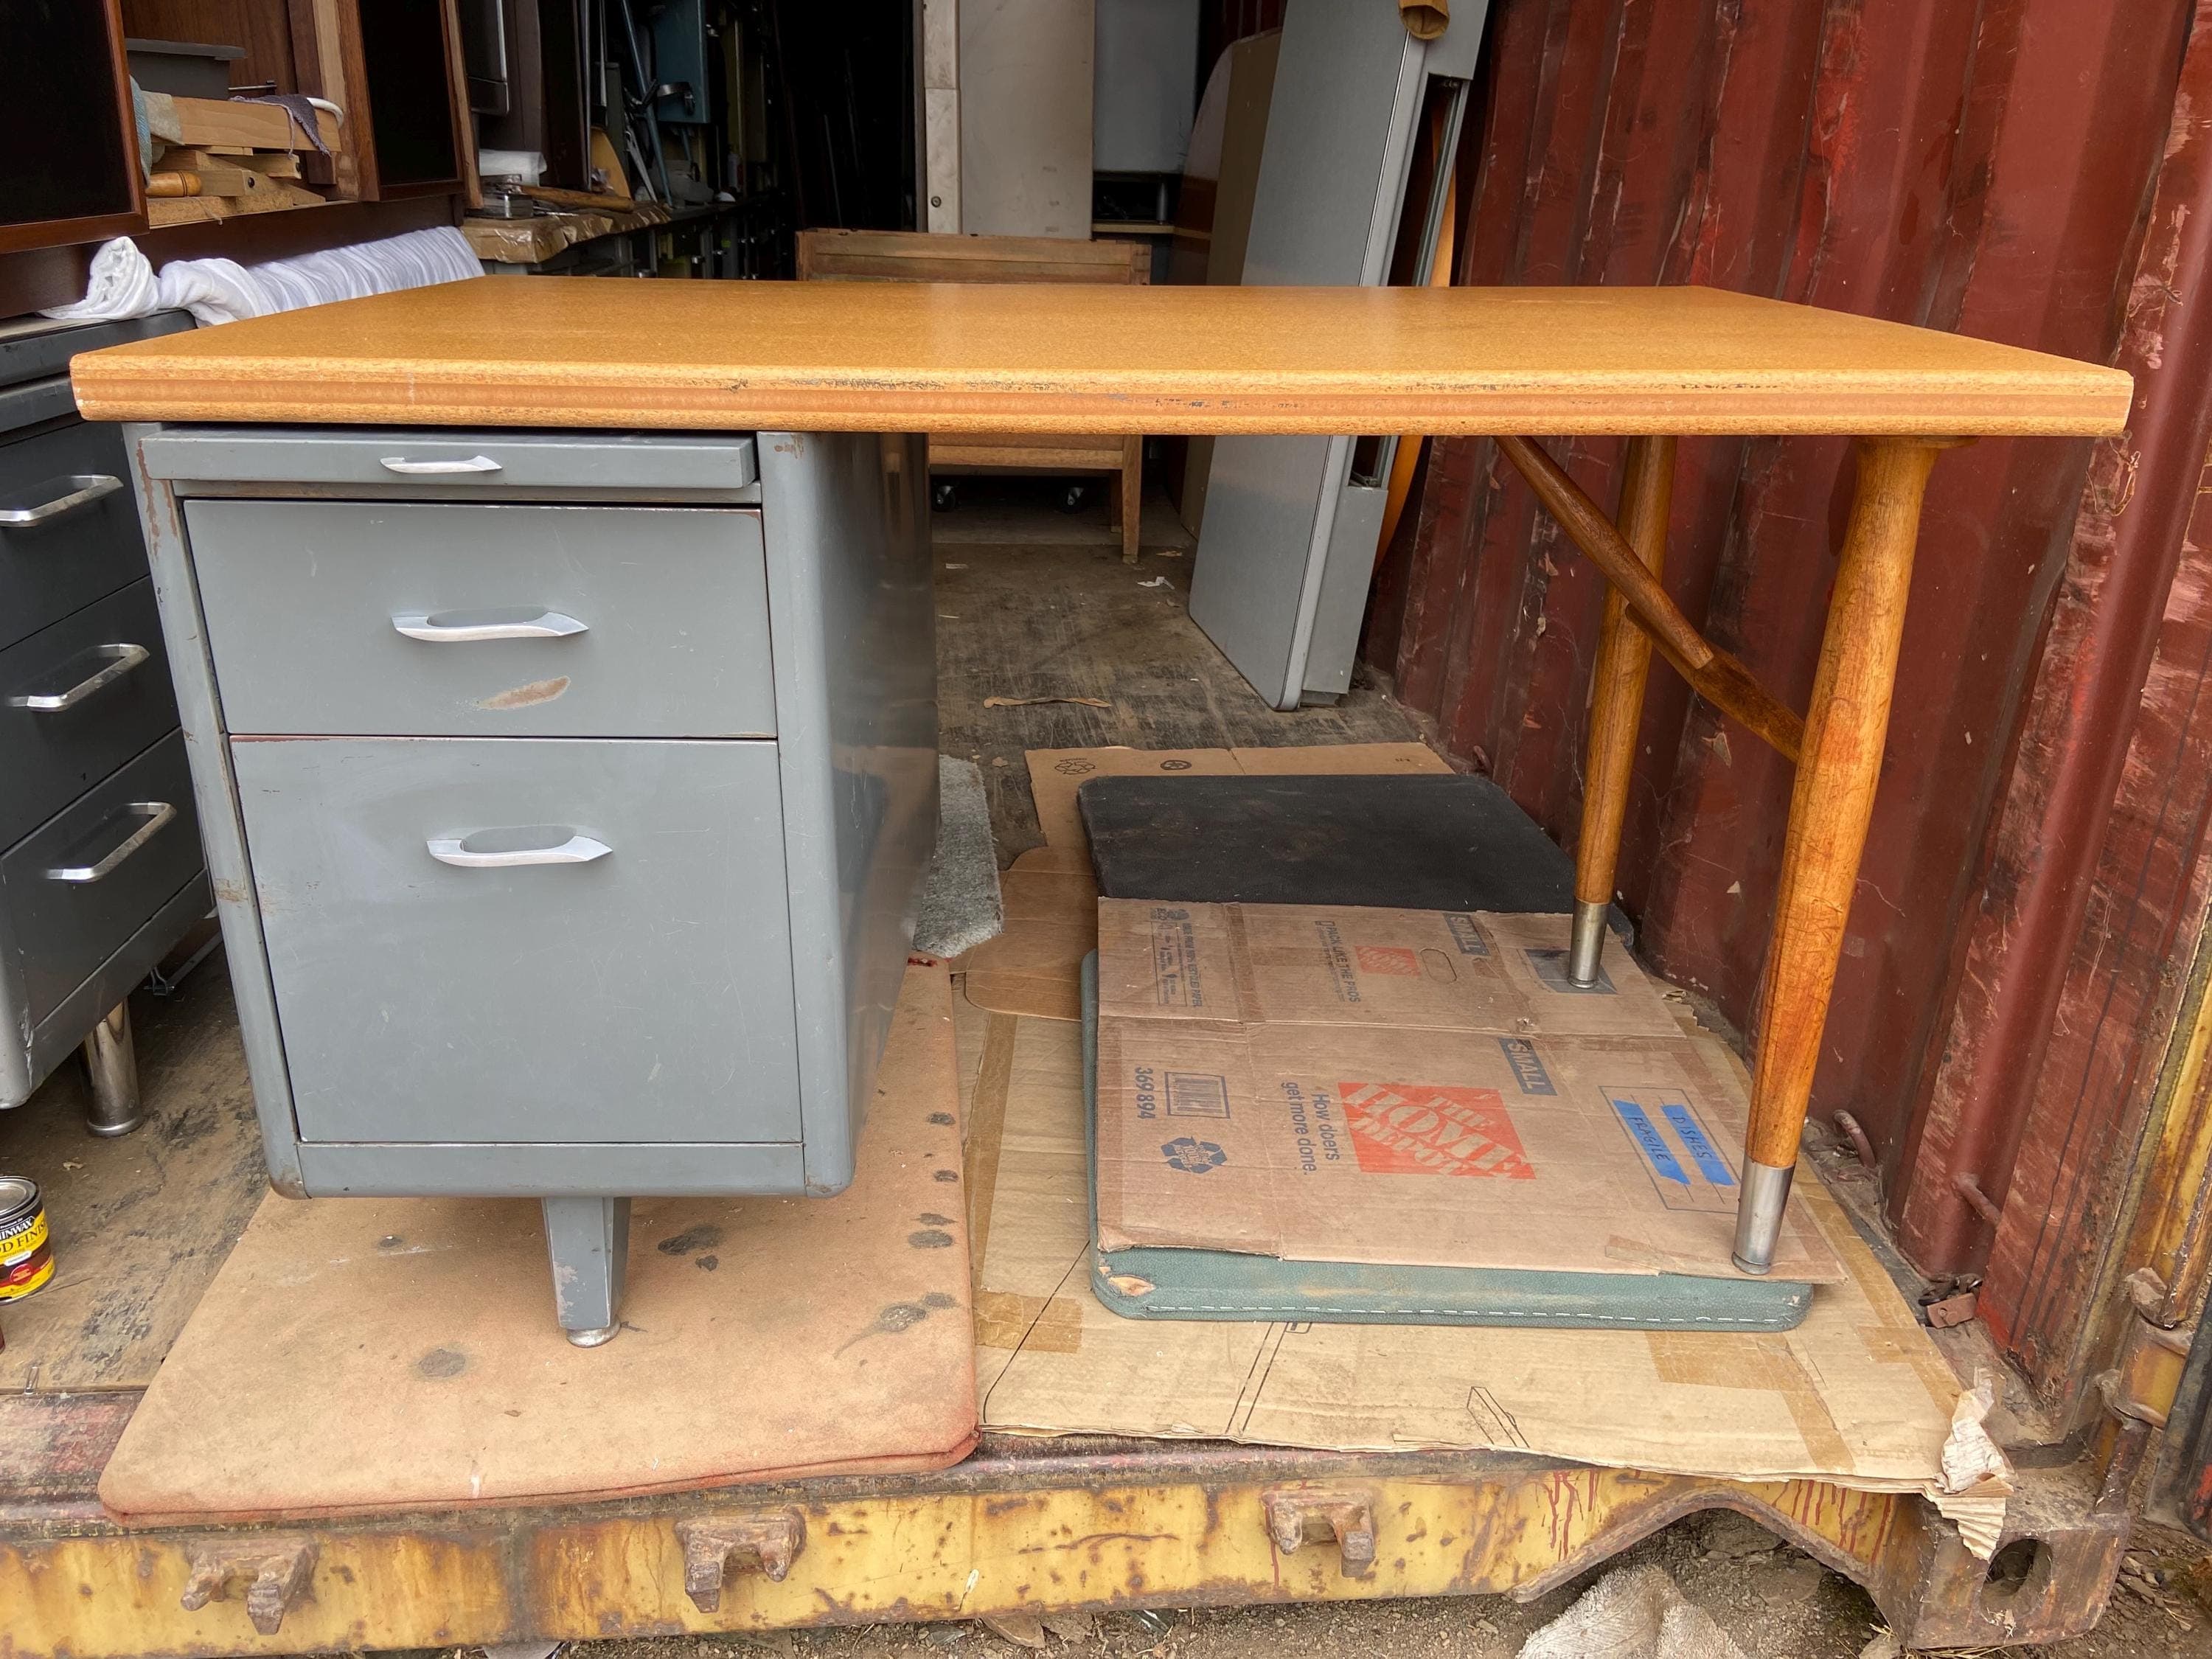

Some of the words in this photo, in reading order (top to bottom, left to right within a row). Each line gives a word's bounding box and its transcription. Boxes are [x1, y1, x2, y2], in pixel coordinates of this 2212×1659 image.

[1326, 926, 1342, 945] PACK
[1449, 917, 1481, 951] SMALL
[1332, 945, 1348, 963] LIKE
[1338, 964, 1354, 980] THE
[1191, 989, 1203, 1007] PAPER
[1343, 981, 1361, 1003] PROS
[1135, 1067, 1155, 1091] 369
[1506, 1041, 1545, 1090] SMALL
[1135, 1093, 1156, 1119] 894
[1281, 1082, 1305, 1101] get
[1289, 1102, 1310, 1135] more
[1311, 1093, 1331, 1121] How
[1425, 1093, 1496, 1131] THE
[1318, 1124, 1340, 1161] doers
[1342, 1083, 1529, 1179] HOME
[1348, 1116, 1471, 1176] DEPOT
[1627, 1116, 1671, 1162] FRAGILE
[1672, 1116, 1713, 1159] DISHES
[1297, 1138, 1318, 1175] done.
[0, 1217, 34, 1240] INWAX
